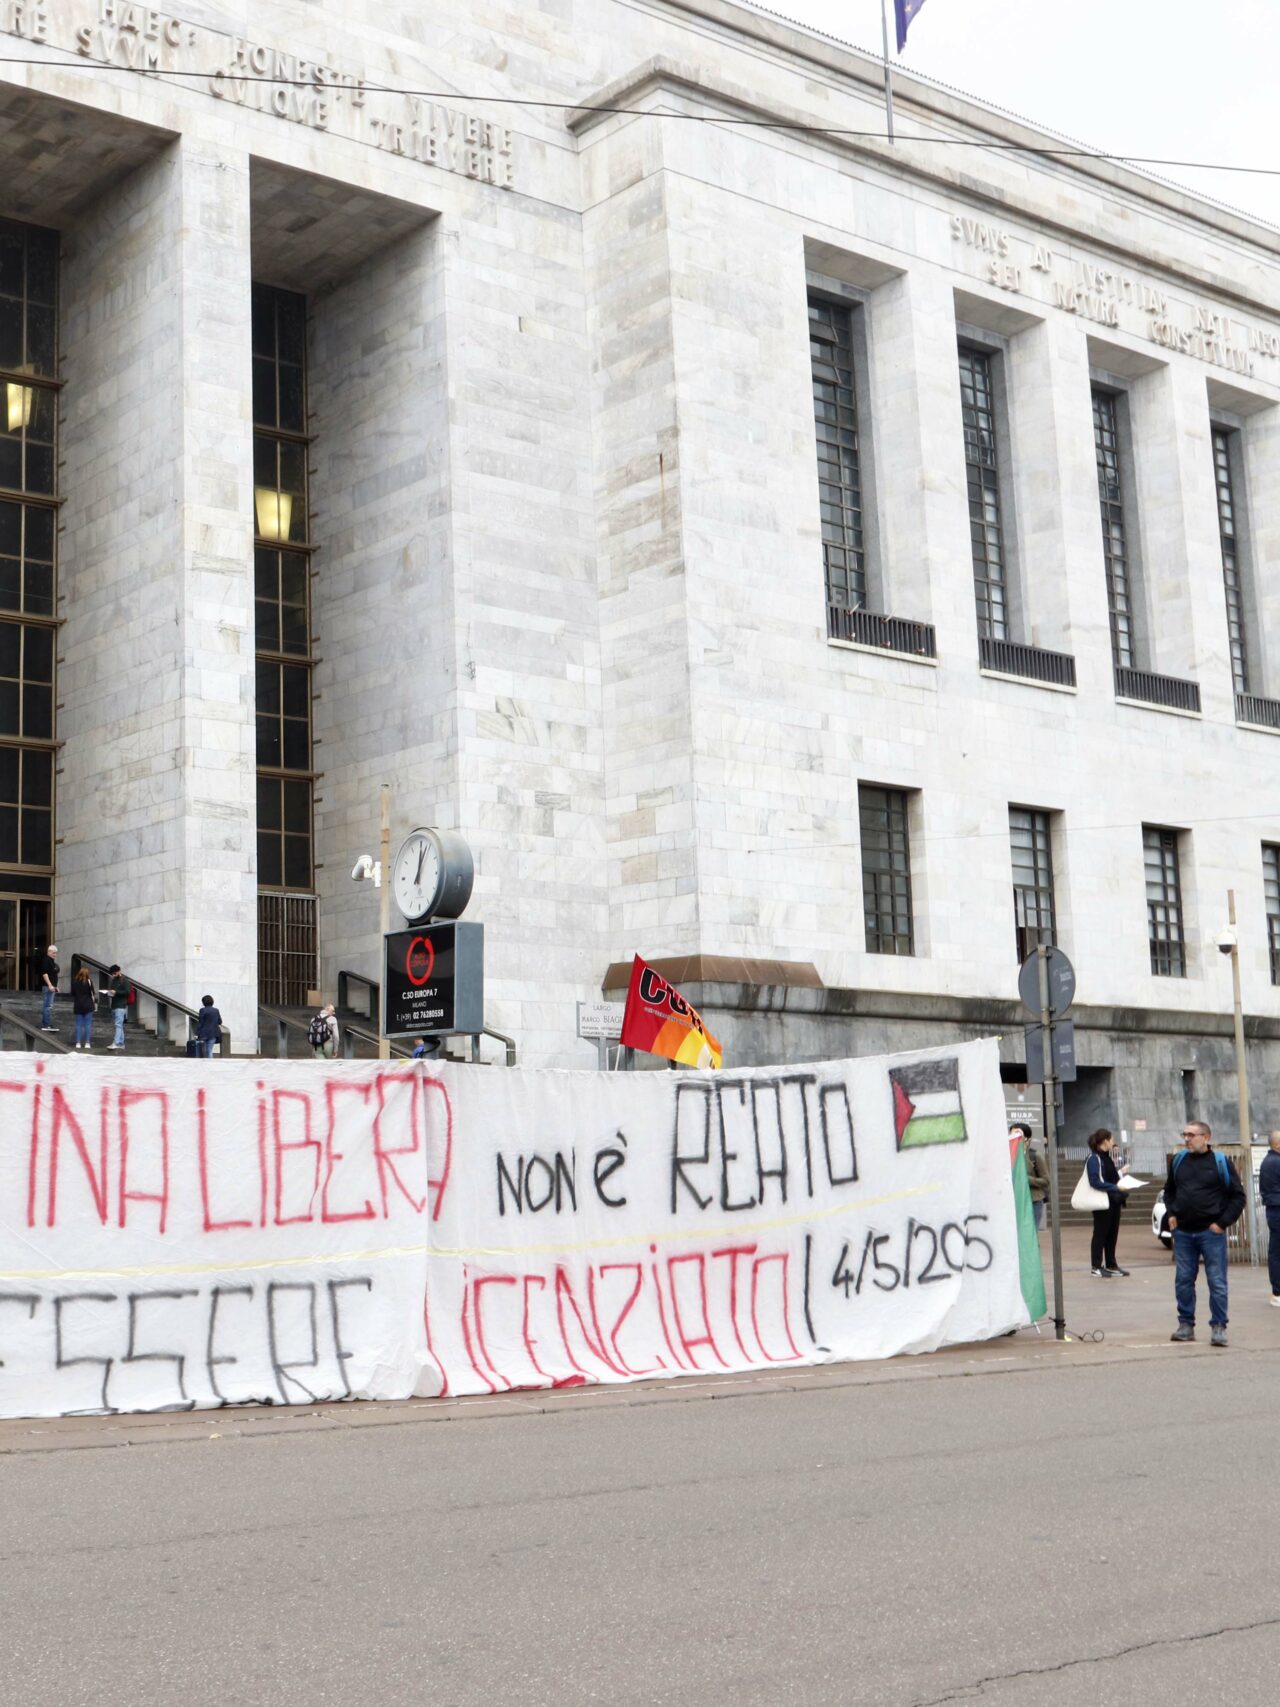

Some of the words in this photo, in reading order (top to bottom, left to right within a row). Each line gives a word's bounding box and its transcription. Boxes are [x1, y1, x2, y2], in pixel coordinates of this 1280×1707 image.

[403, 93, 512, 156] VIVERE
[370, 119, 514, 190] TRIBVERE
[949, 215, 1010, 259] SVMVS
[1053, 281, 1119, 330] NATVRA
[412, 1011, 420, 1020] 02
[414, 989, 433, 999] EUROPA
[592, 1004, 612, 1012] LARGO
[196, 1071, 453, 1234] LIBERA
[495, 1148, 577, 1217] NON
[670, 1074, 859, 1214] REATO
